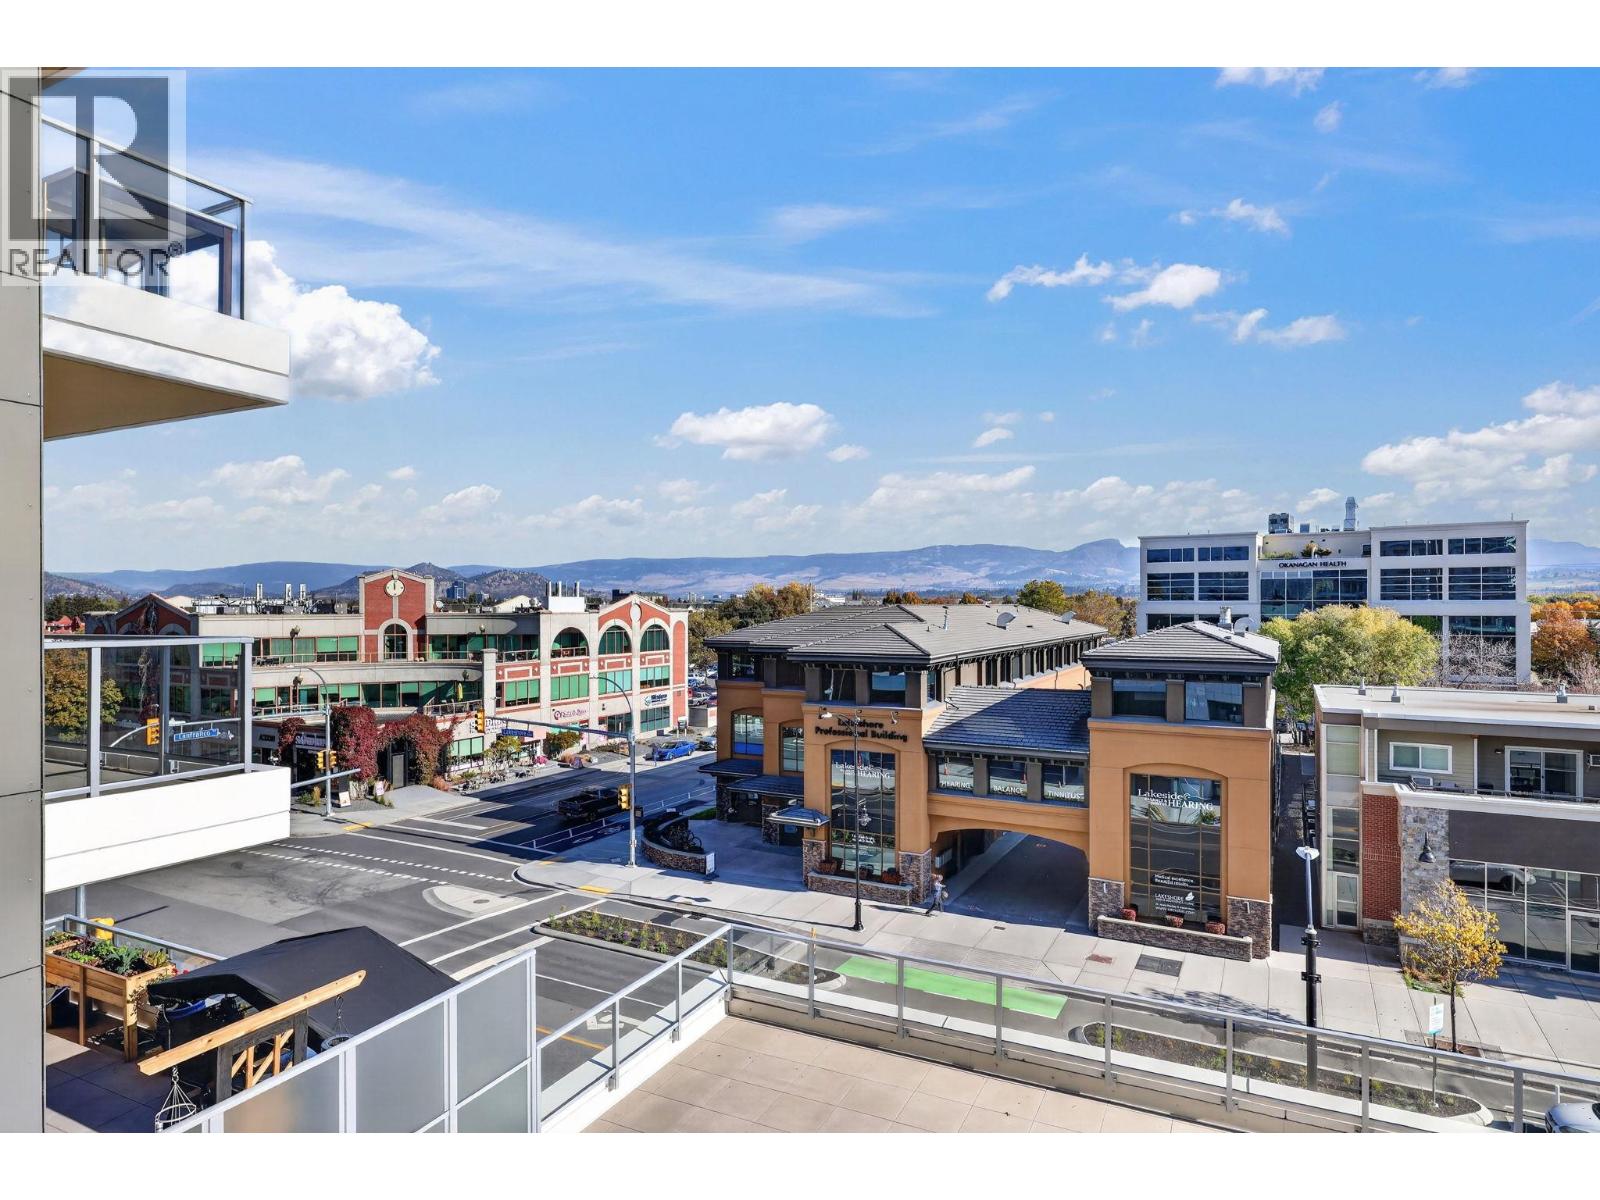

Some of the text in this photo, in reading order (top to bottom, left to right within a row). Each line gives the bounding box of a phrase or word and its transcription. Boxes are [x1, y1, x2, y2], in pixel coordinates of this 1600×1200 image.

[837, 718, 884, 729] Lakshore
[871, 731, 908, 742] Building
[857, 769, 890, 779] HEARING
[941, 780, 972, 789] HEARING
[993, 785, 1024, 795] BALANCE
[1048, 790, 1081, 799] TINNITUS
[1138, 789, 1184, 800] Lakeside
[1168, 800, 1213, 810] HEARING
